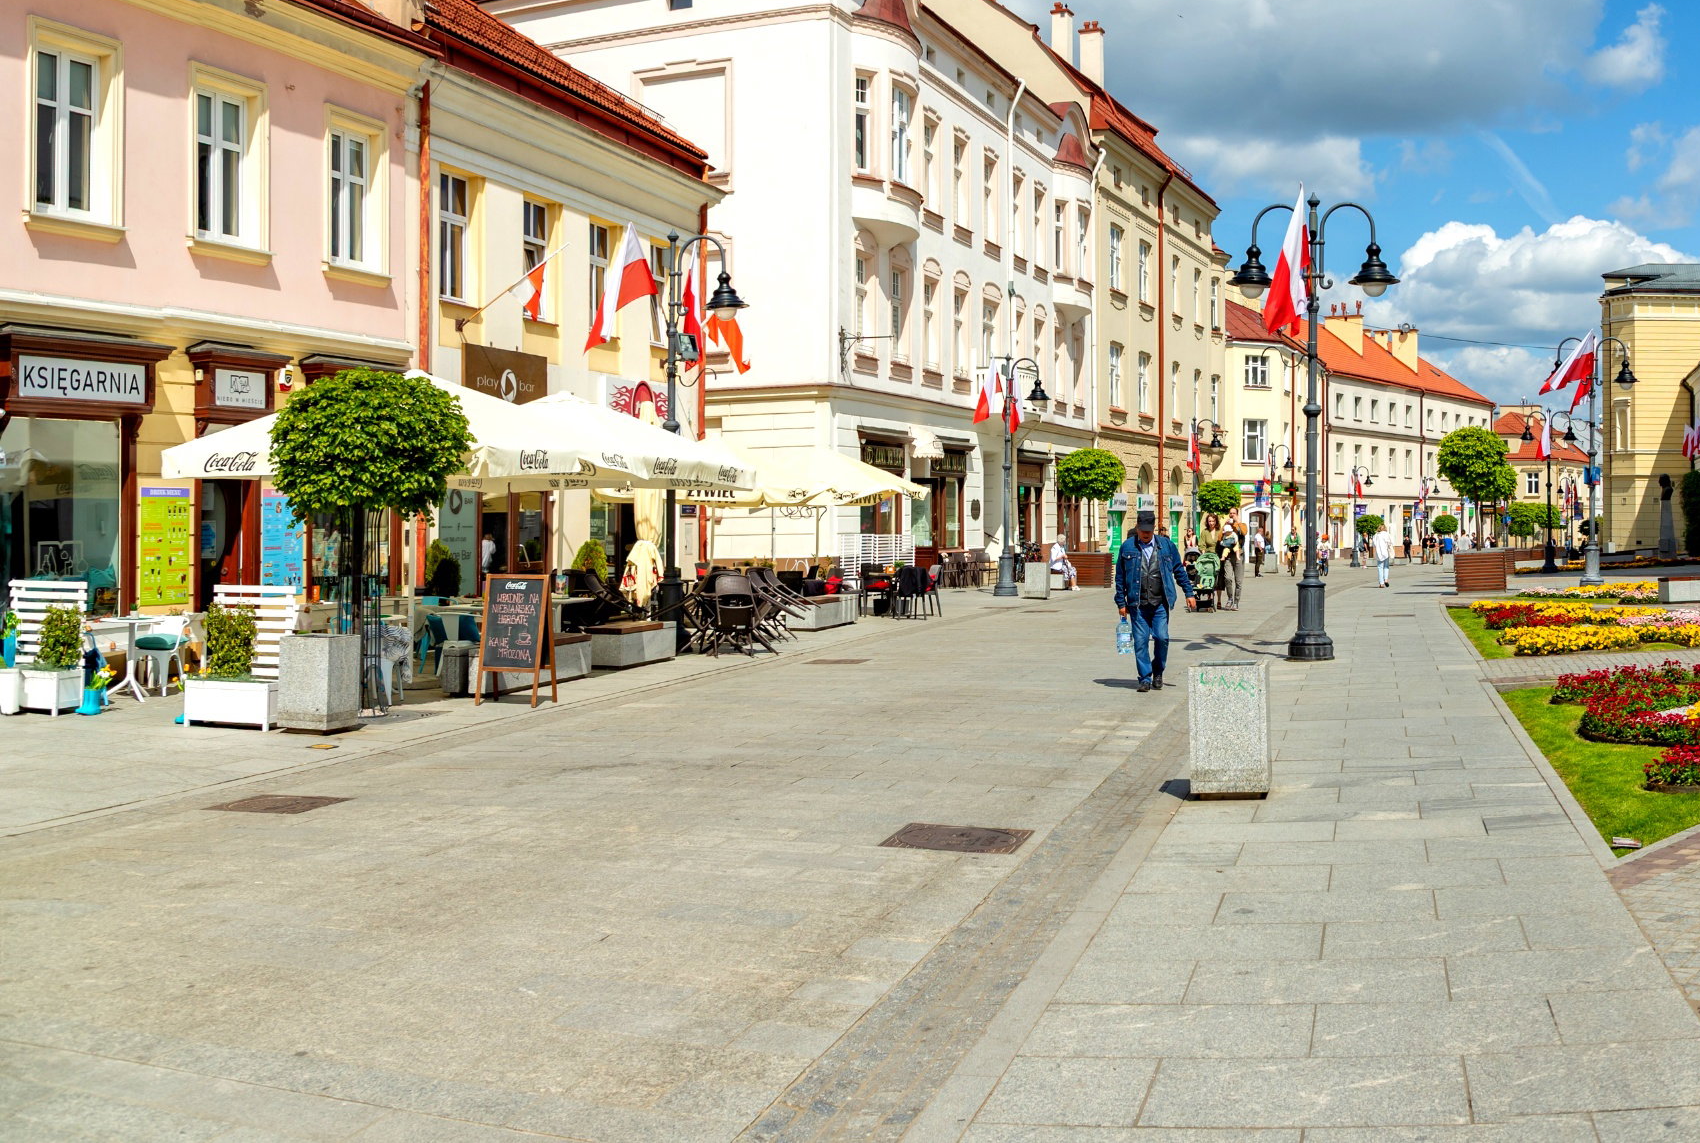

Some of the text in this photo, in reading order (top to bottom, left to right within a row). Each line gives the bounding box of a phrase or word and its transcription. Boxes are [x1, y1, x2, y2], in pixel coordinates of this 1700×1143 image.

[23, 365, 140, 396] KSIĘGARNIA
[477, 375, 535, 393] play bar
[204, 451, 259, 473] Coca-Cola
[520, 449, 549, 470] Coca-Cola
[653, 457, 677, 476] Coca-Cola
[717, 465, 739, 484] Coca-Cola
[529, 593, 539, 604] NA
[508, 626, 512, 636] I
[488, 637, 509, 648] KAWĘ
